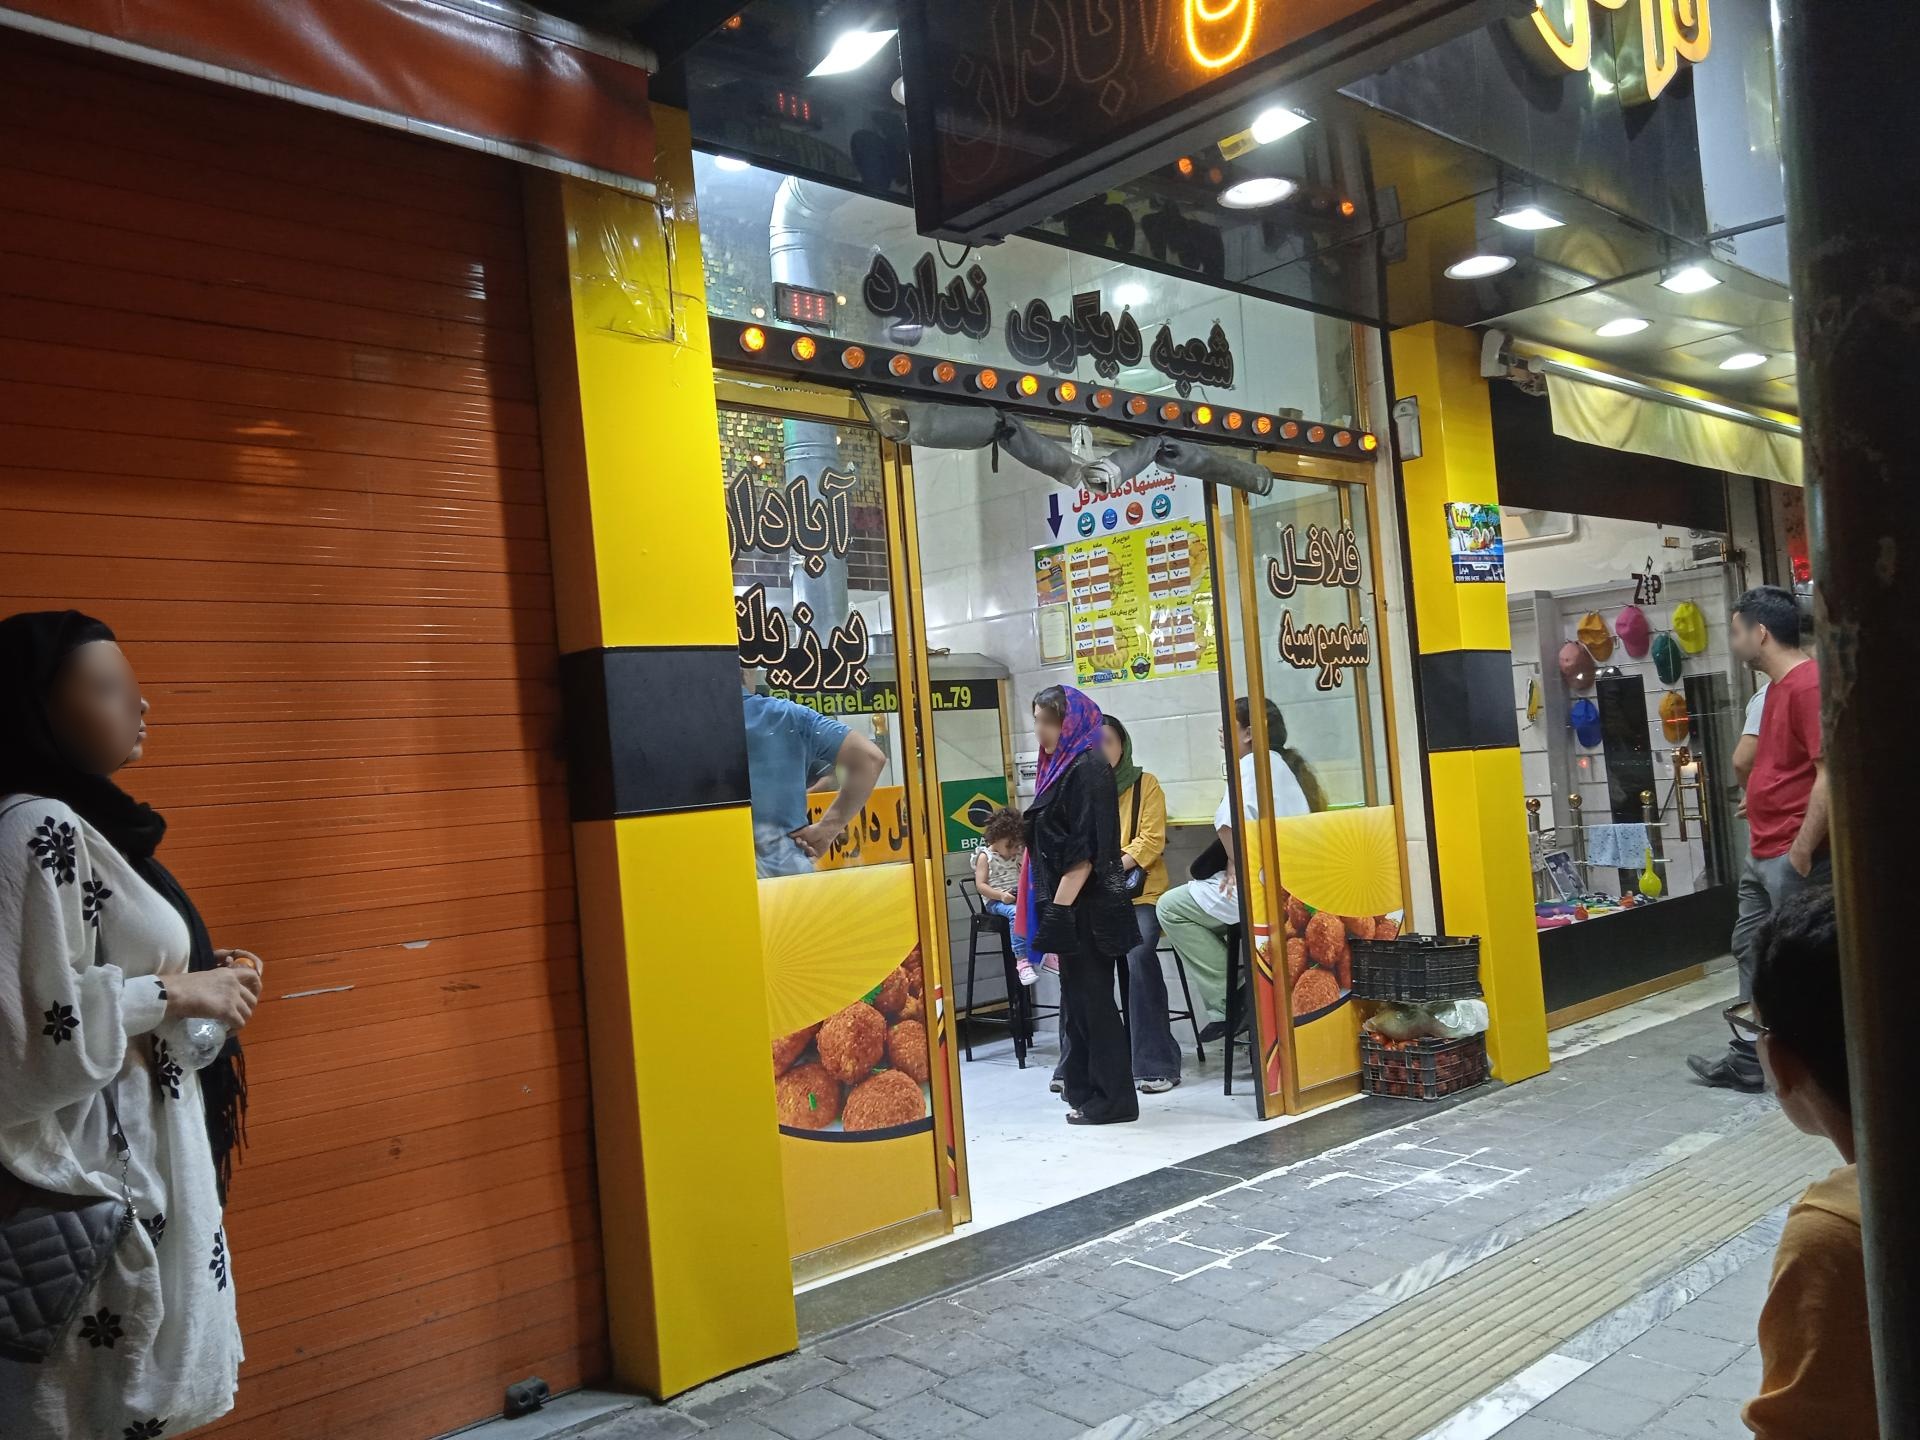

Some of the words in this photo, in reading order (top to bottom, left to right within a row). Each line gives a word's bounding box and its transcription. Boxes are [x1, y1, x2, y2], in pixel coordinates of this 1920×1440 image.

[863, 252, 992, 340] ندارد
[1004, 290, 1143, 380] دیگری
[1150, 320, 1234, 398] شعبه
[727, 464, 858, 578] آبادا
[1268, 523, 1362, 599] فلافل
[1279, 609, 1371, 691] سمبوسه
